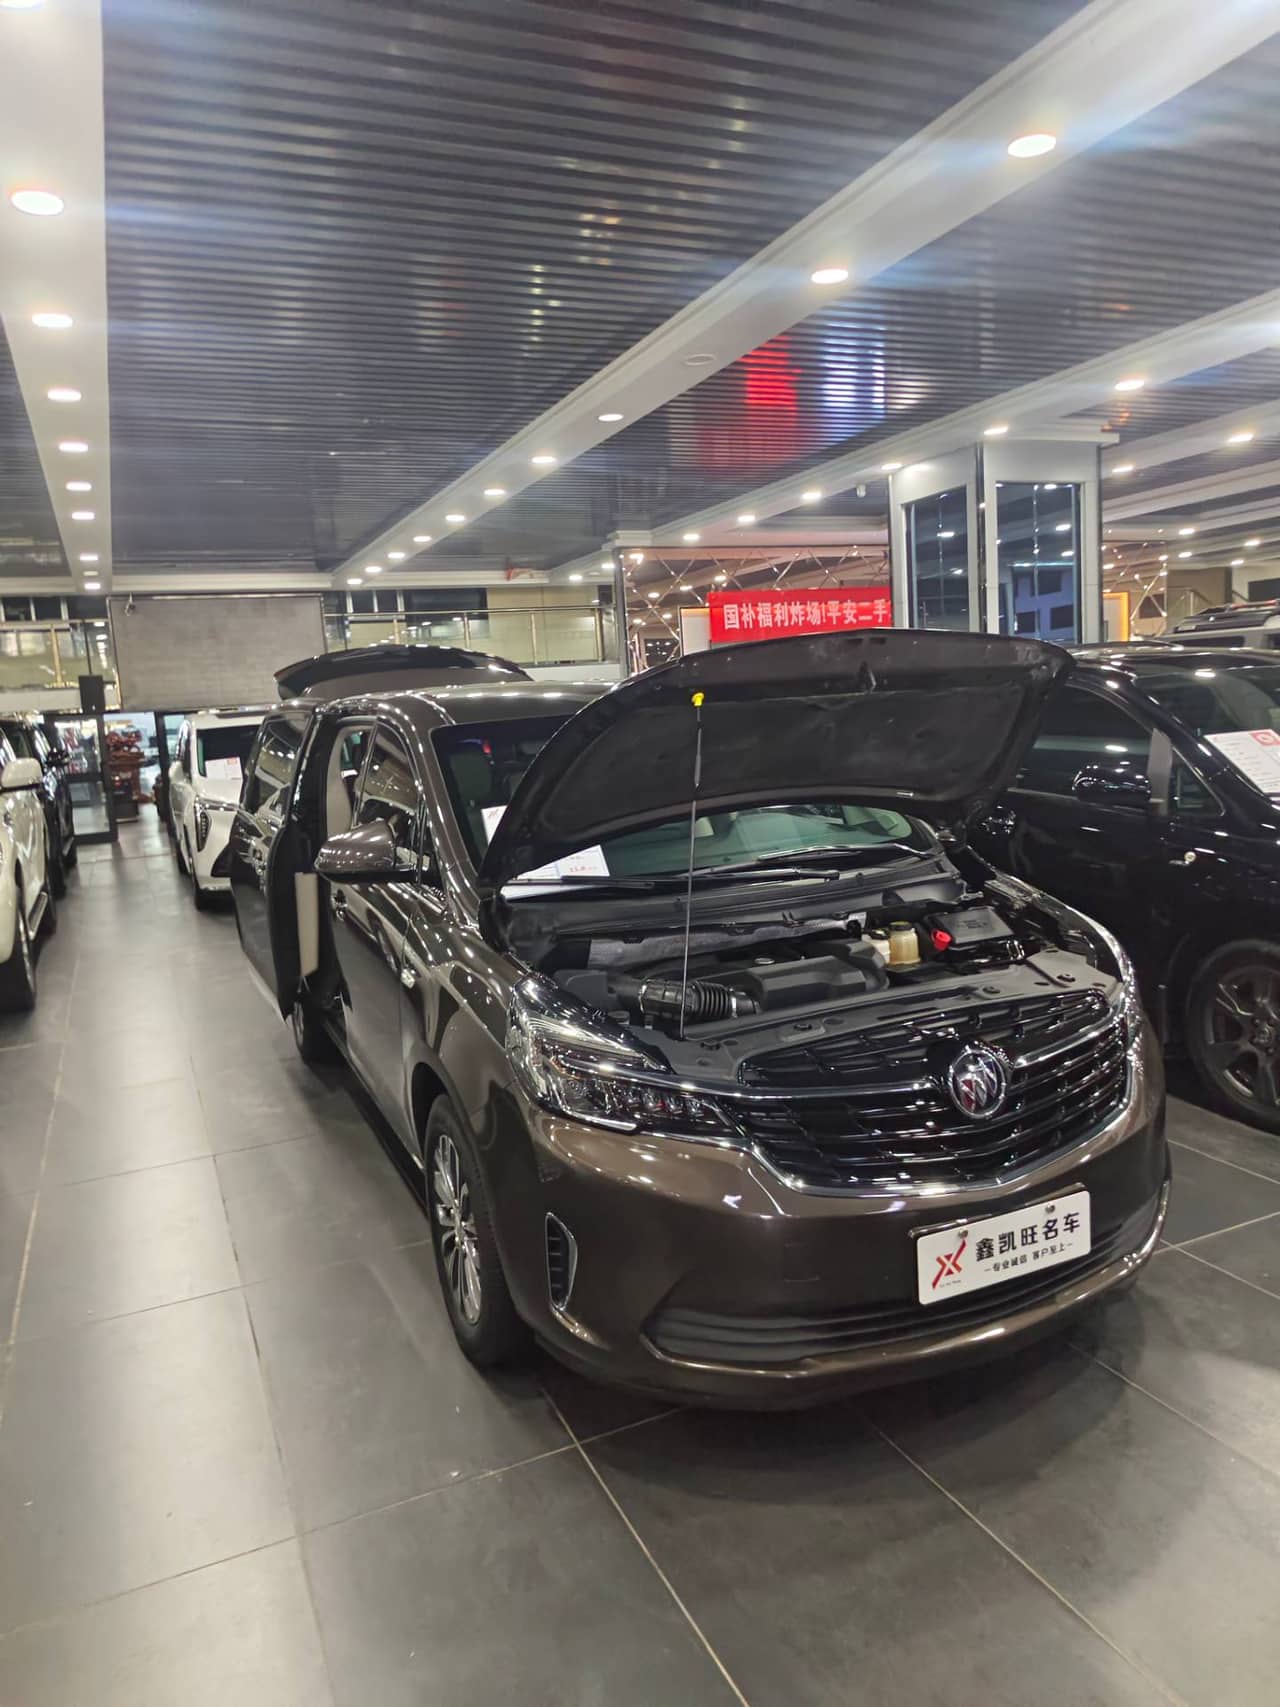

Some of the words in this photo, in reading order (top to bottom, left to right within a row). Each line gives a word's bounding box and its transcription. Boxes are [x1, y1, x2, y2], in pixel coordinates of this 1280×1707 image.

[723, 599, 893, 630] 国补福利炸场!平安二手
[976, 1212, 1080, 1262] 鑫凯旺名车
